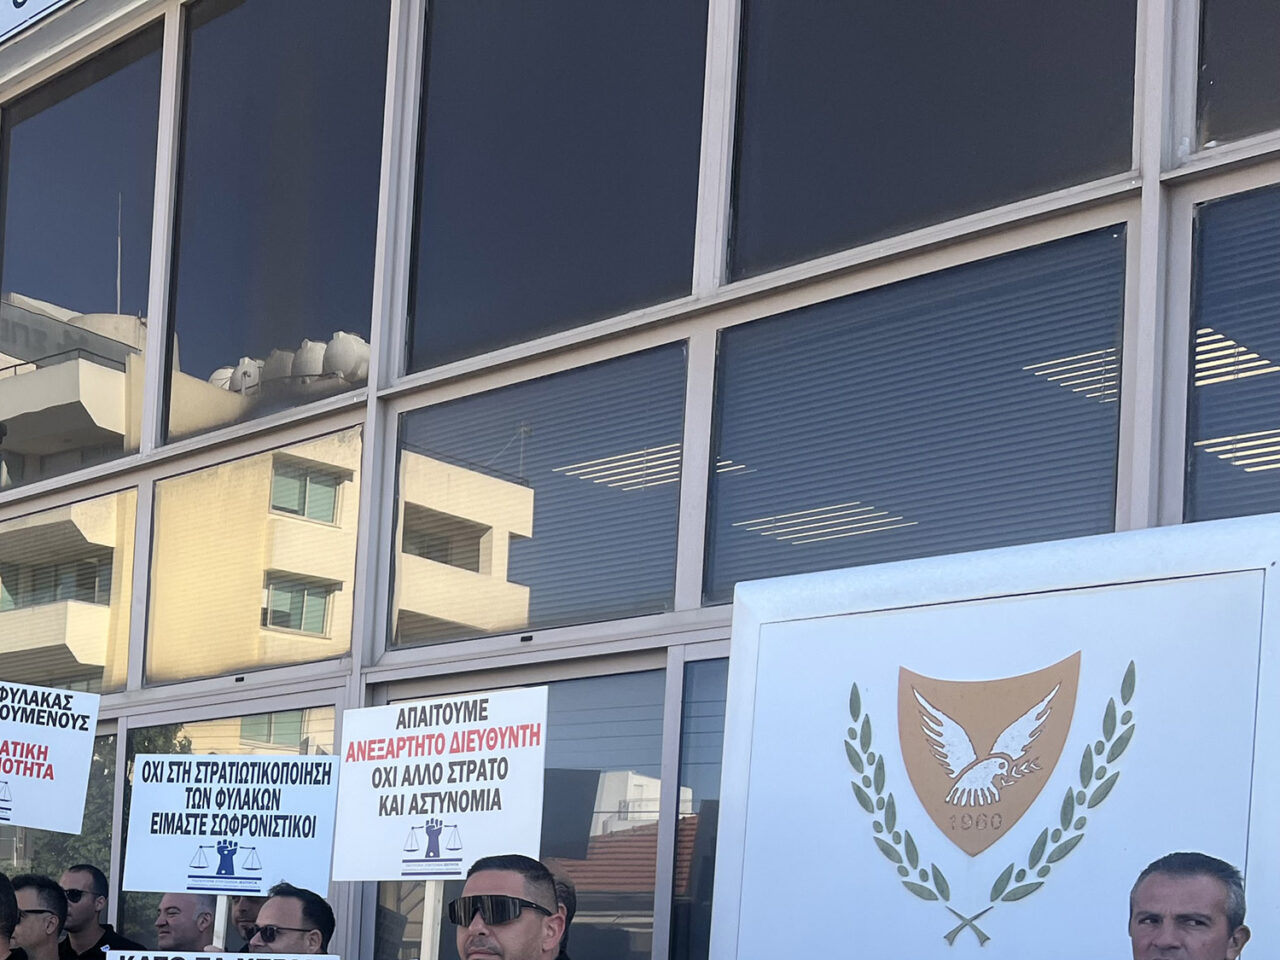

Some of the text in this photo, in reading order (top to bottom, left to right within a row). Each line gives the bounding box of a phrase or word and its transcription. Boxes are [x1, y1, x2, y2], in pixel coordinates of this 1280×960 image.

[396, 699, 489, 730] ΑΠΑΙΤΟΥΜΕ
[345, 723, 541, 763] ΑΝΕΞΑΡΤΗΤΟ ΔΙΕΥΘΥΝΤΗ
[142, 761, 332, 786] ΟΧΙ ΣΤΗ ΣΤΡΑΤΙΩΤΙΚΟΠΟΙΗΣΗ
[372, 757, 509, 789] ΟΧΙ ΑΛΛΟ ΣΤΡΑΤΟ
[185, 787, 281, 811] ΤΩΝ ΦΥΛΑΚΩΝ
[379, 788, 502, 816] ΚΑΙ ΑΣΤΥΝΟΜΙΑ
[150, 813, 317, 838] ΕΙΜΑΣΤΕ ΣΩΦΡΟΝΙΣΤΙΚΟΙ
[949, 813, 1004, 831] 1960
